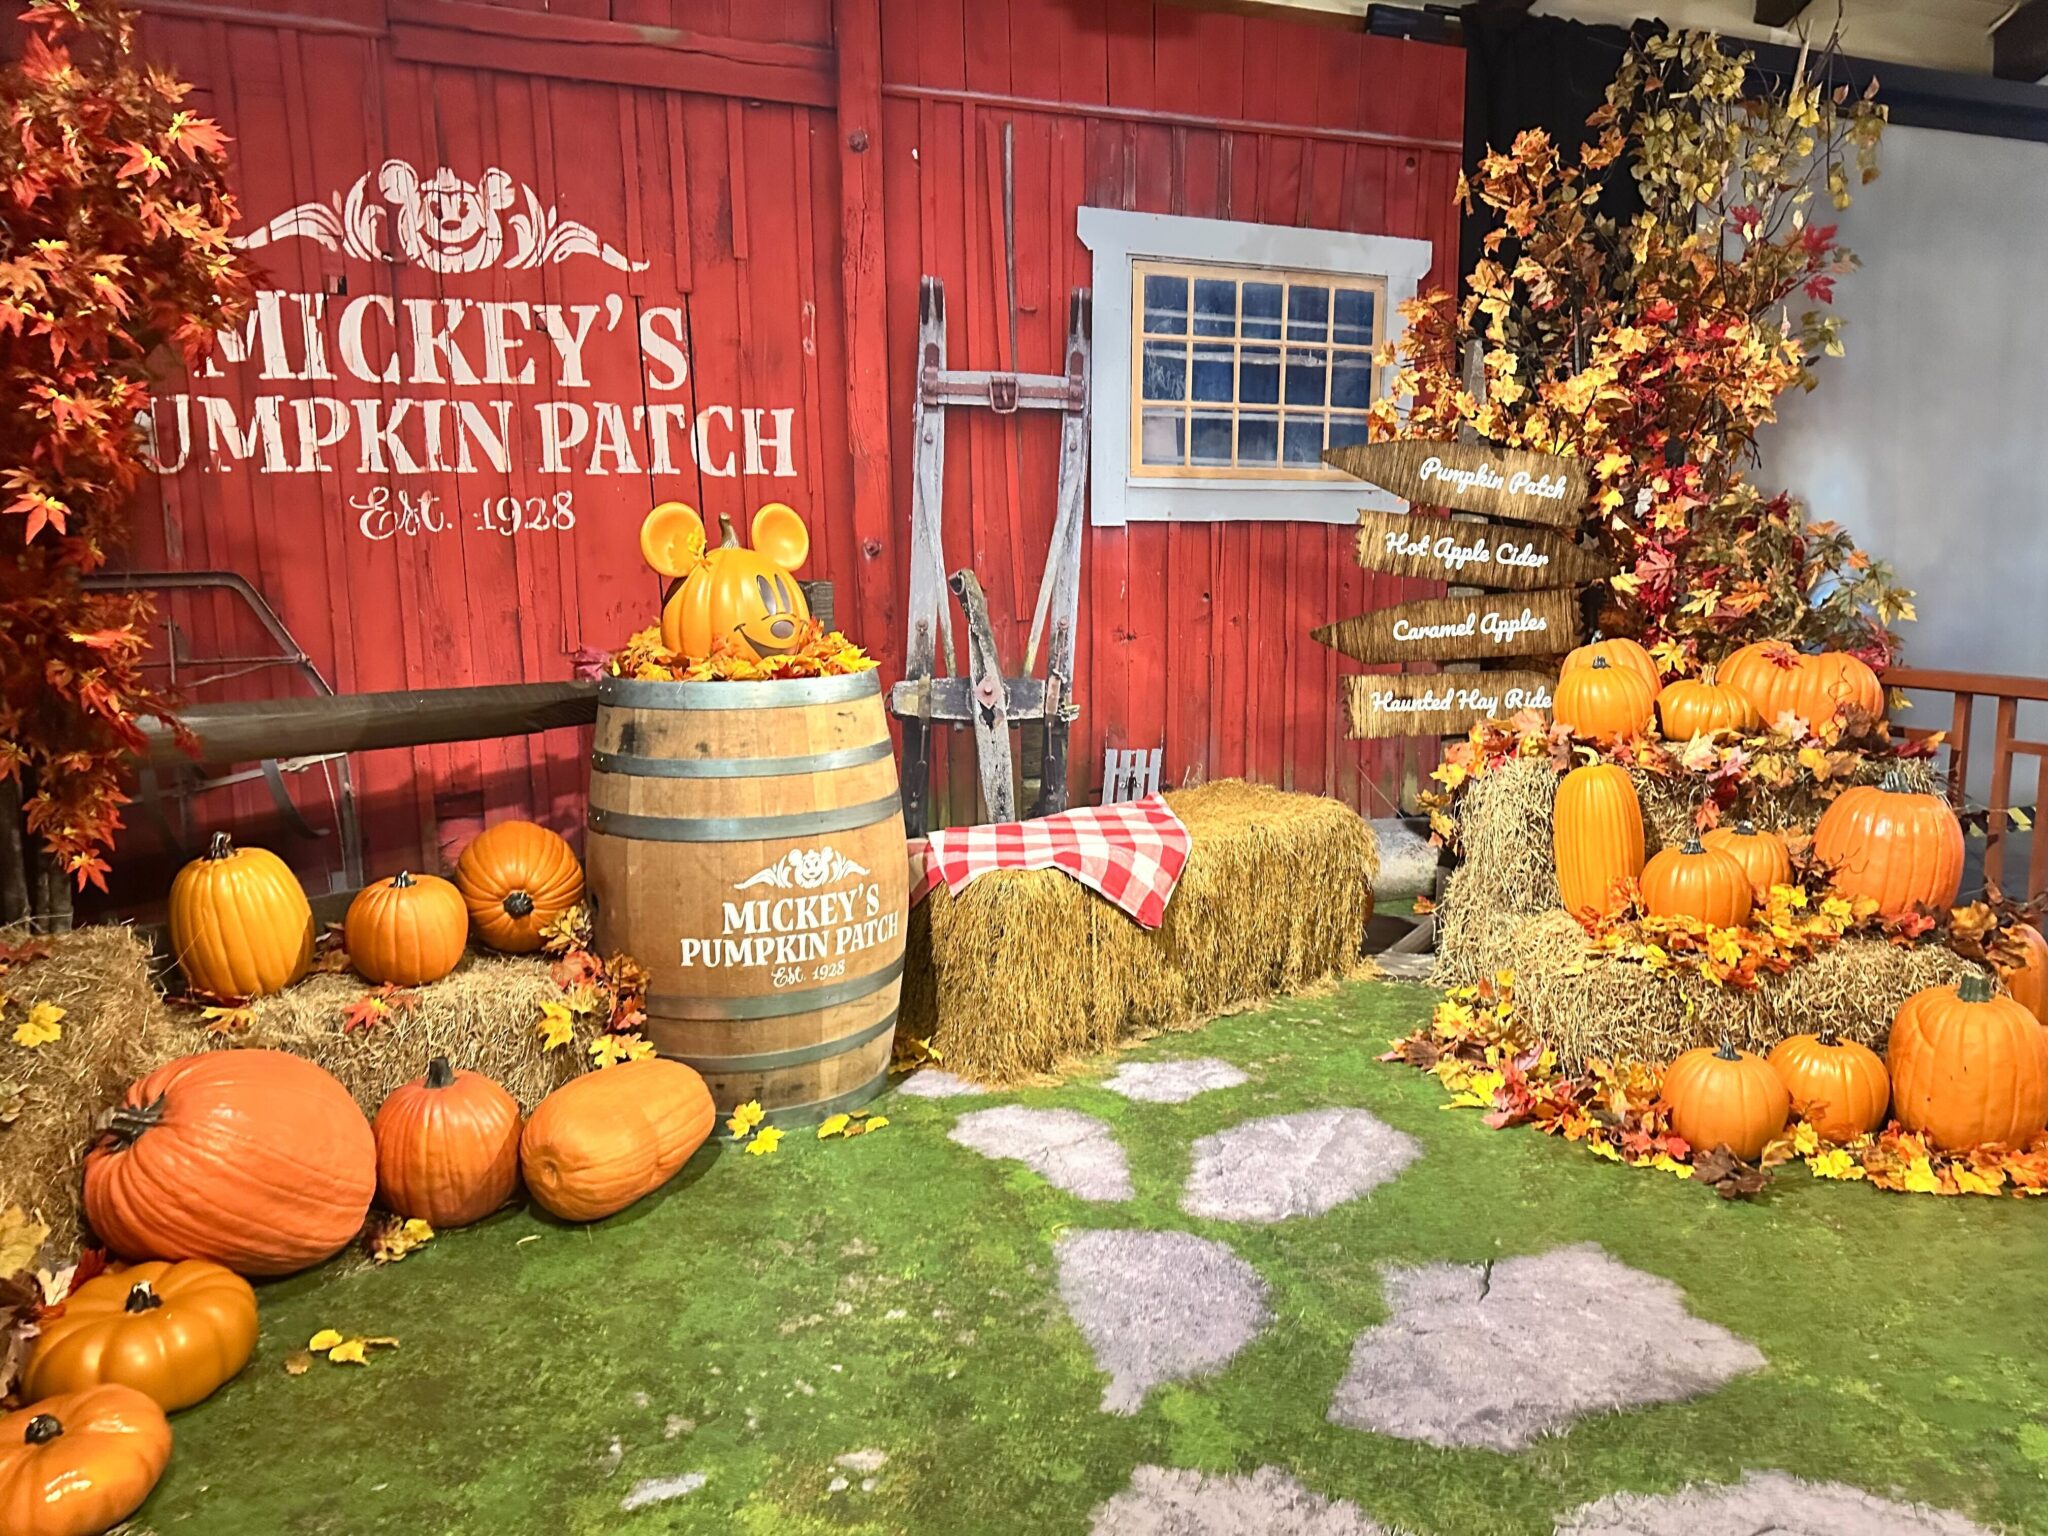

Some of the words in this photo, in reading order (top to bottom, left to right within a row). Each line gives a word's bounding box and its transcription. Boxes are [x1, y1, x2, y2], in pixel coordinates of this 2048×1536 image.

[193, 289, 690, 392] MICKEY'S
[138, 394, 514, 474] UMPKIN
[534, 400, 798, 477] PATCH
[1420, 457, 1504, 494] Pumpkin
[1508, 471, 1568, 500] Patch
[349, 486, 454, 541] Est.
[474, 489, 577, 536] 1928
[1385, 533, 1428, 557] Hot
[1433, 537, 1490, 570] Apple
[1495, 543, 1550, 568] Cider
[1393, 614, 1476, 641] Caramel
[1480, 609, 1548, 643] Apples
[1371, 689, 1454, 713] Haunted
[1457, 690, 1498, 717] Hay
[1504, 687, 1553, 710] Ride
[722, 884, 880, 935] MICKEY'S
[680, 932, 828, 968] PUMPKIN
[835, 912, 899, 956] PATCH
[771, 969, 807, 988] Est.
[811, 959, 846, 982] 1928
